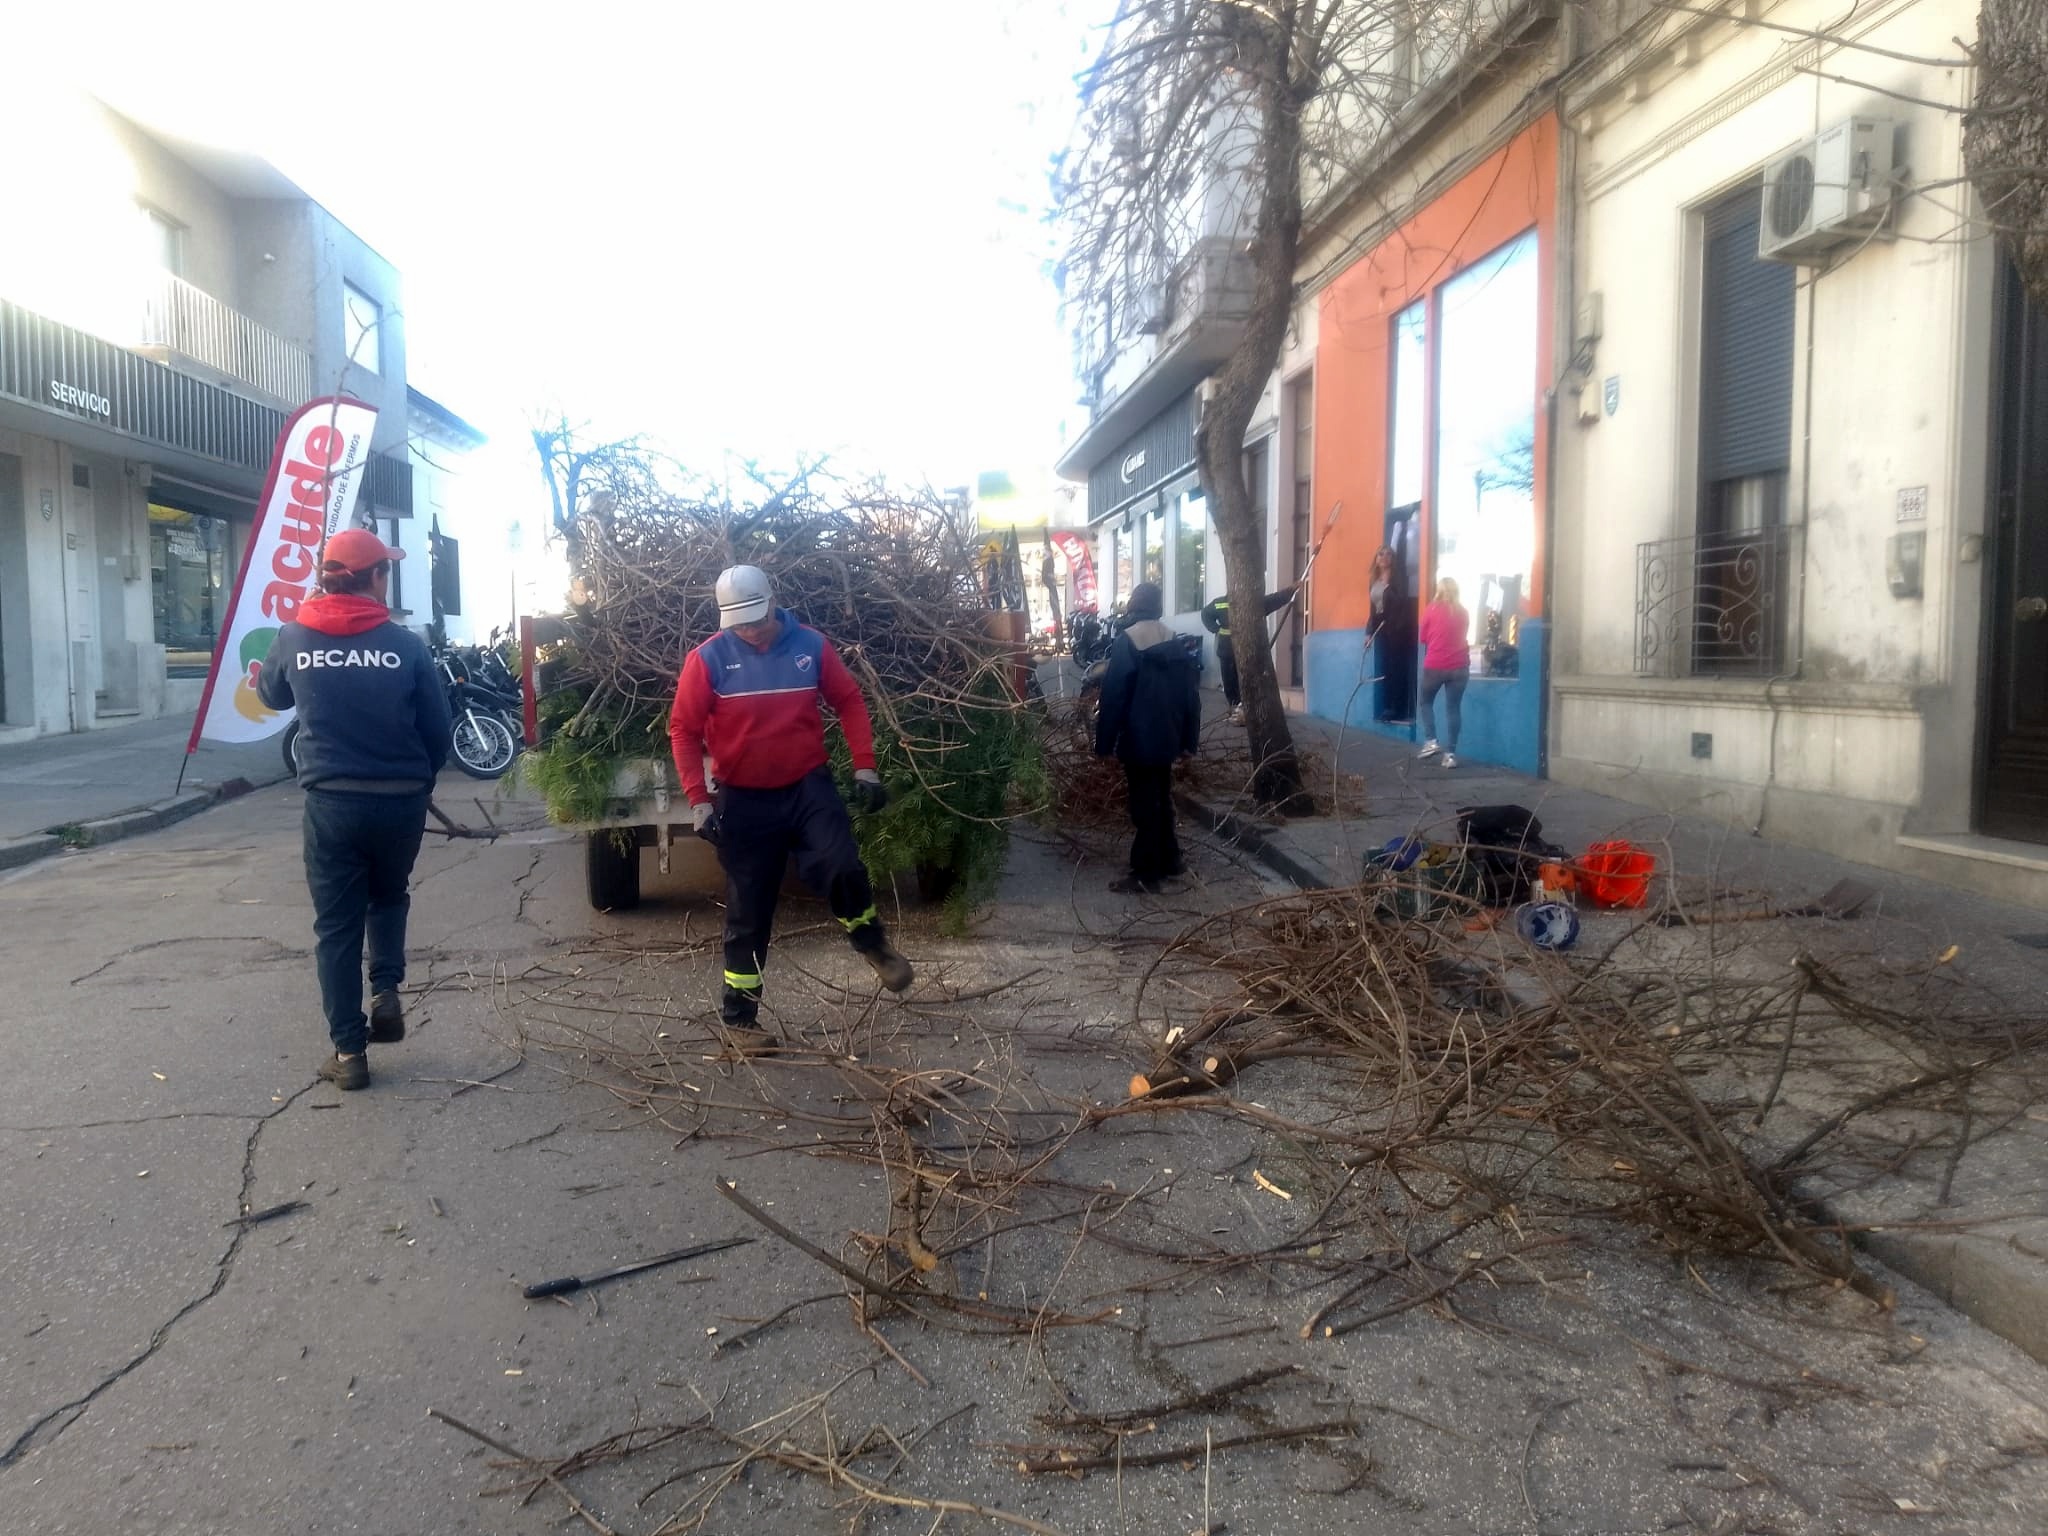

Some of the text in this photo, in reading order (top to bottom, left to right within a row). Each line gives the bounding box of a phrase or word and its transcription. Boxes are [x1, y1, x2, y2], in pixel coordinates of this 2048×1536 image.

[51, 380, 110, 417] SERVICIO
[261, 425, 344, 623] acude
[328, 495, 344, 533] CUIDADO
[339, 481, 348, 495] DE
[296, 649, 401, 671] DECANO
